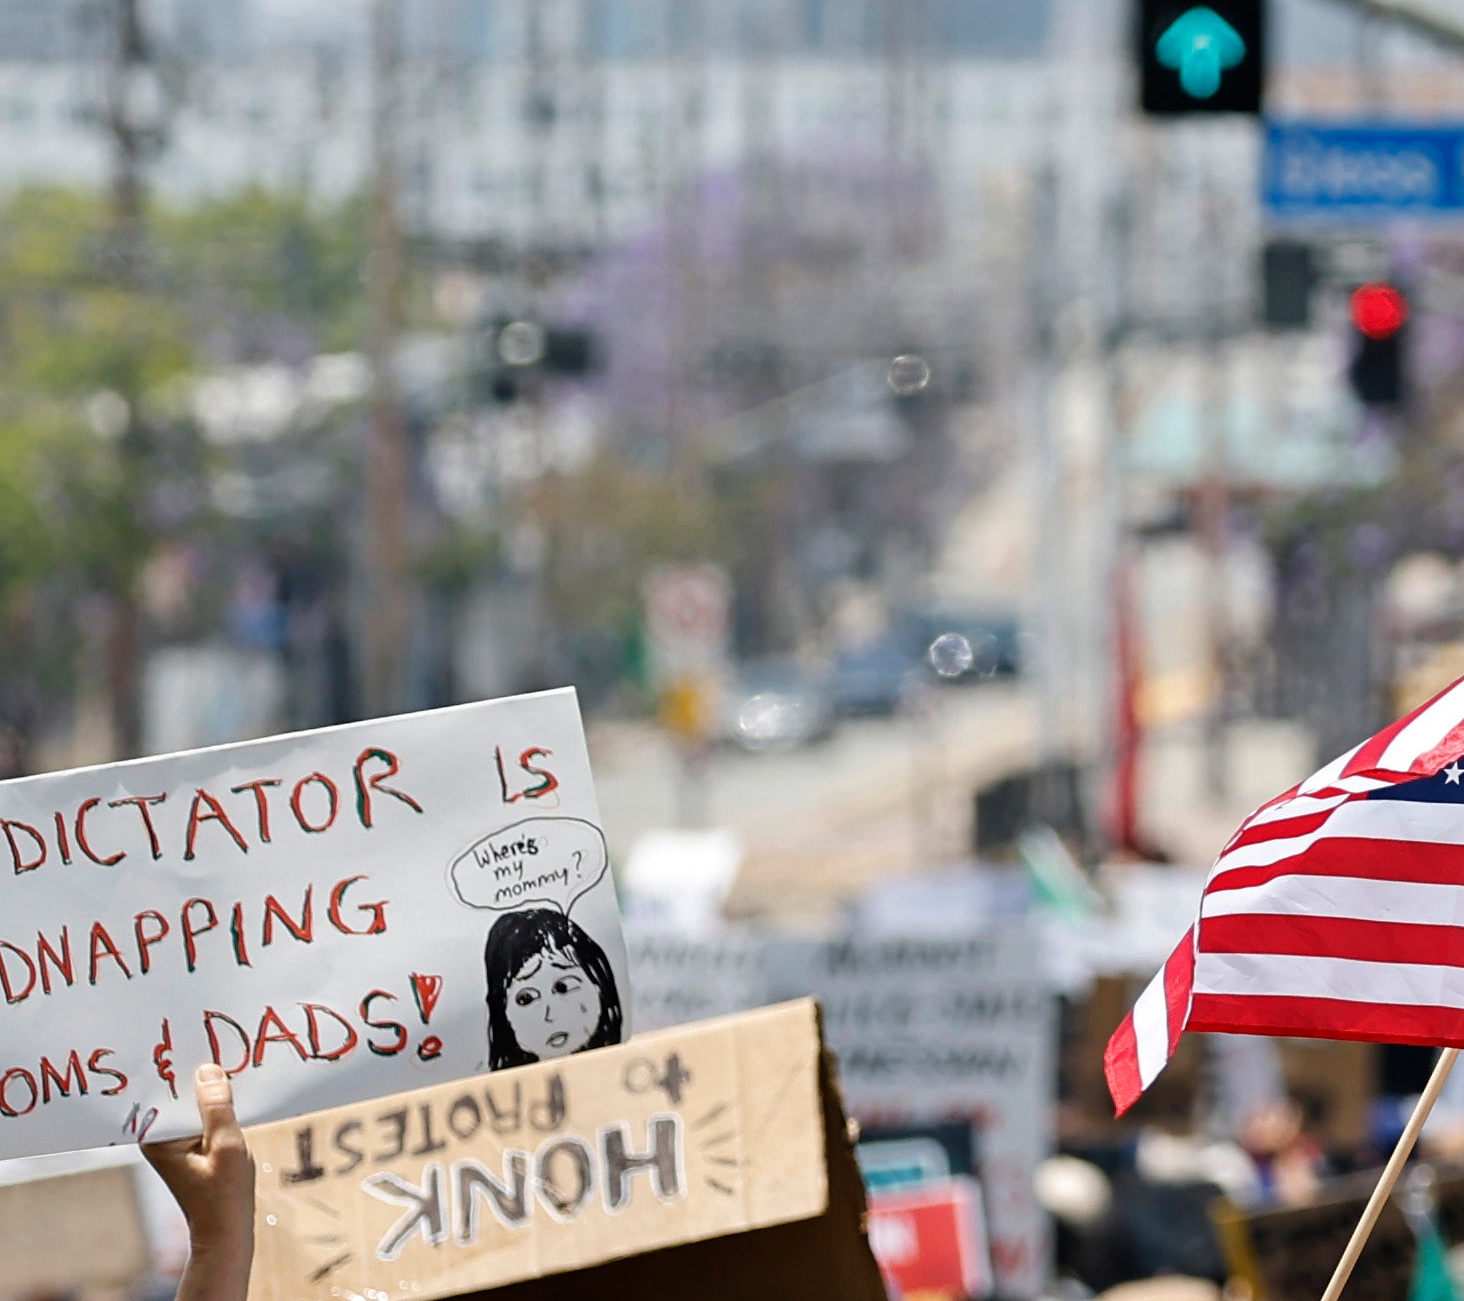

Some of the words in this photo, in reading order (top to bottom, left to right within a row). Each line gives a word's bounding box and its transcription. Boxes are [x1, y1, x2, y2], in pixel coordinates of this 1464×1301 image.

[0, 746, 424, 874] DICTATOR
[495, 744, 560, 805] IS
[473, 834, 539, 868] Where's
[494, 861, 523, 880] my
[153, 1016, 179, 1099] &
[202, 971, 443, 1081] DADS!
[622, 1051, 691, 1106] to
[280, 1072, 567, 1188] PROTEST
[361, 1111, 689, 1261] HONK
